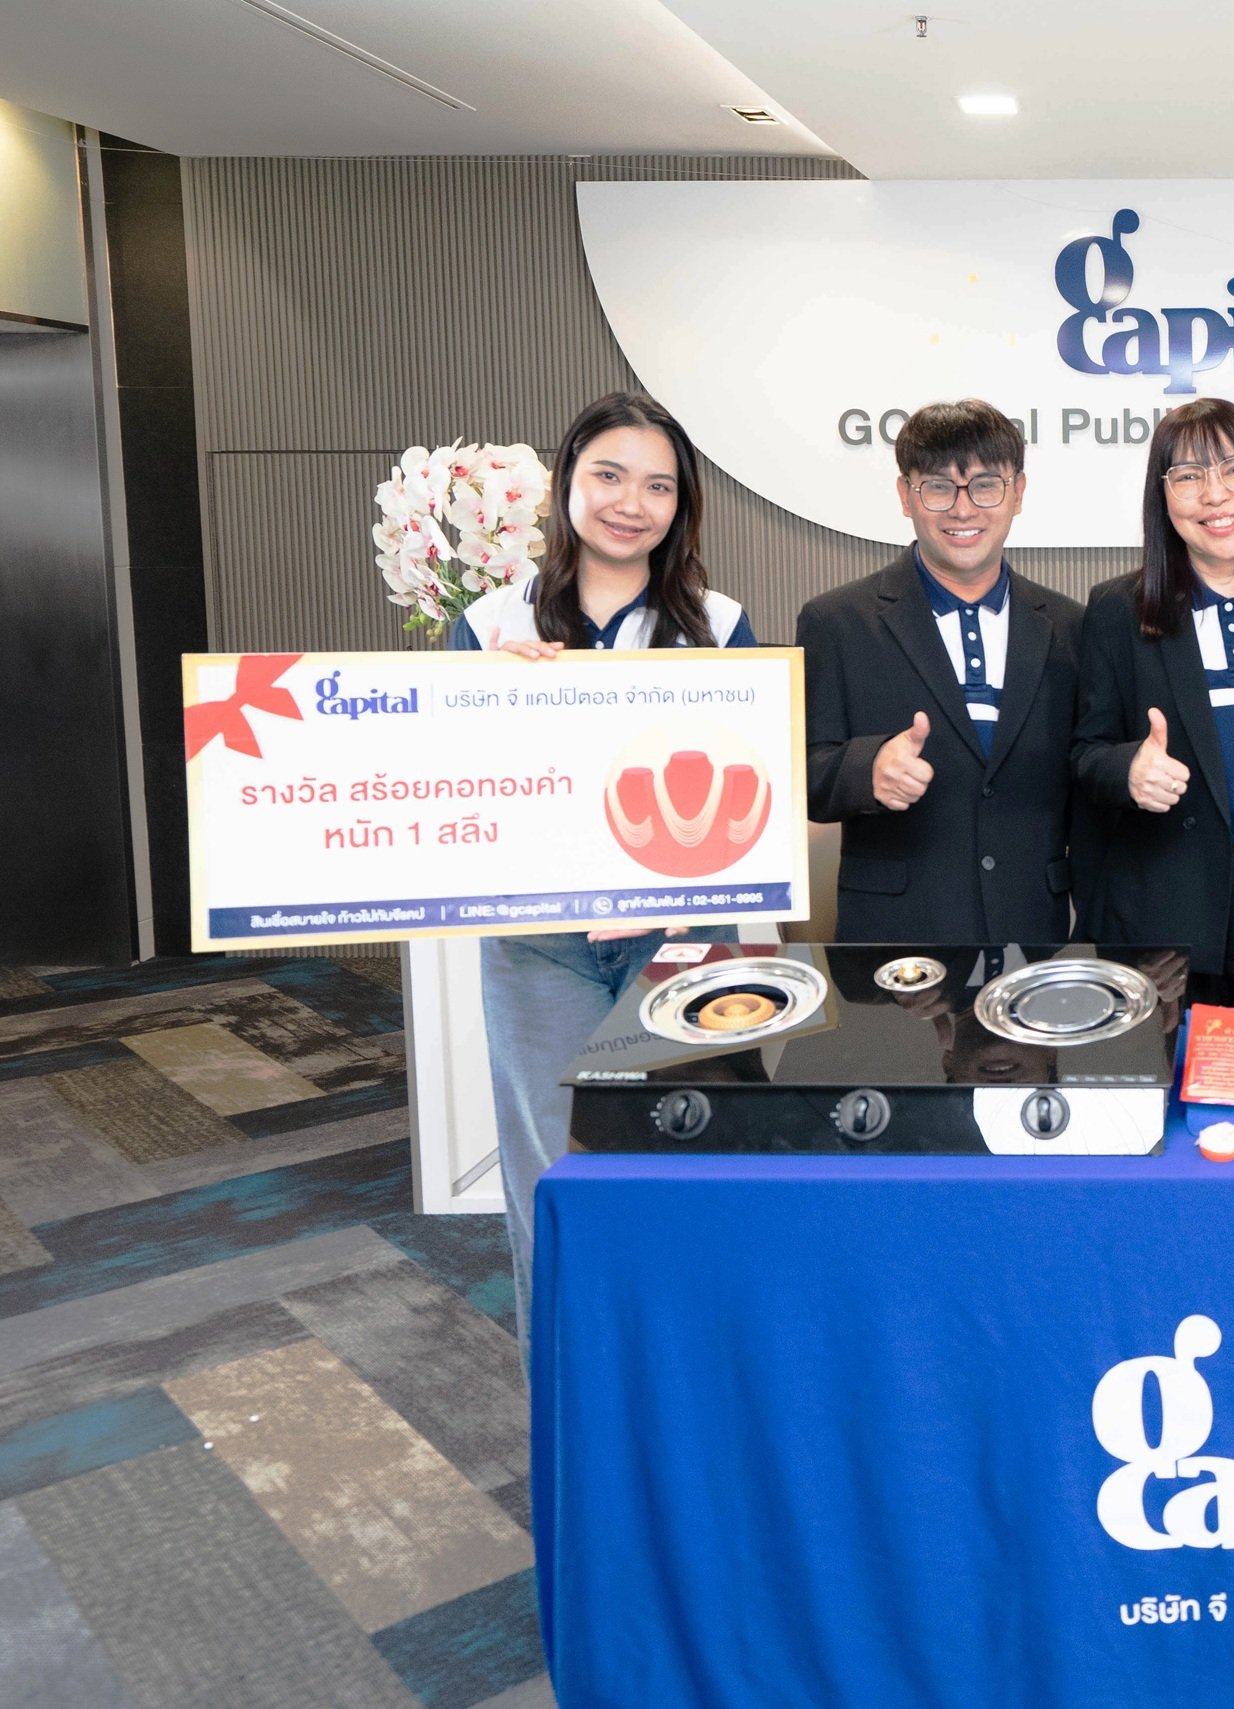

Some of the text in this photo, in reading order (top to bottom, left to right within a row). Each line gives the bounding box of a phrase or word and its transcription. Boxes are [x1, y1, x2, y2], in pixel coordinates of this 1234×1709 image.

[445, 685, 755, 708] บริษัท จี แคปปิตอล จำกัด (มหาชน)
[241, 767, 573, 806] รางวัล สร้อยคอทองคำ
[325, 812, 498, 849] หนัก 1 สลึง
[1120, 1594, 1201, 1626] บริษัท
[1208, 1592, 1227, 1622] จี
